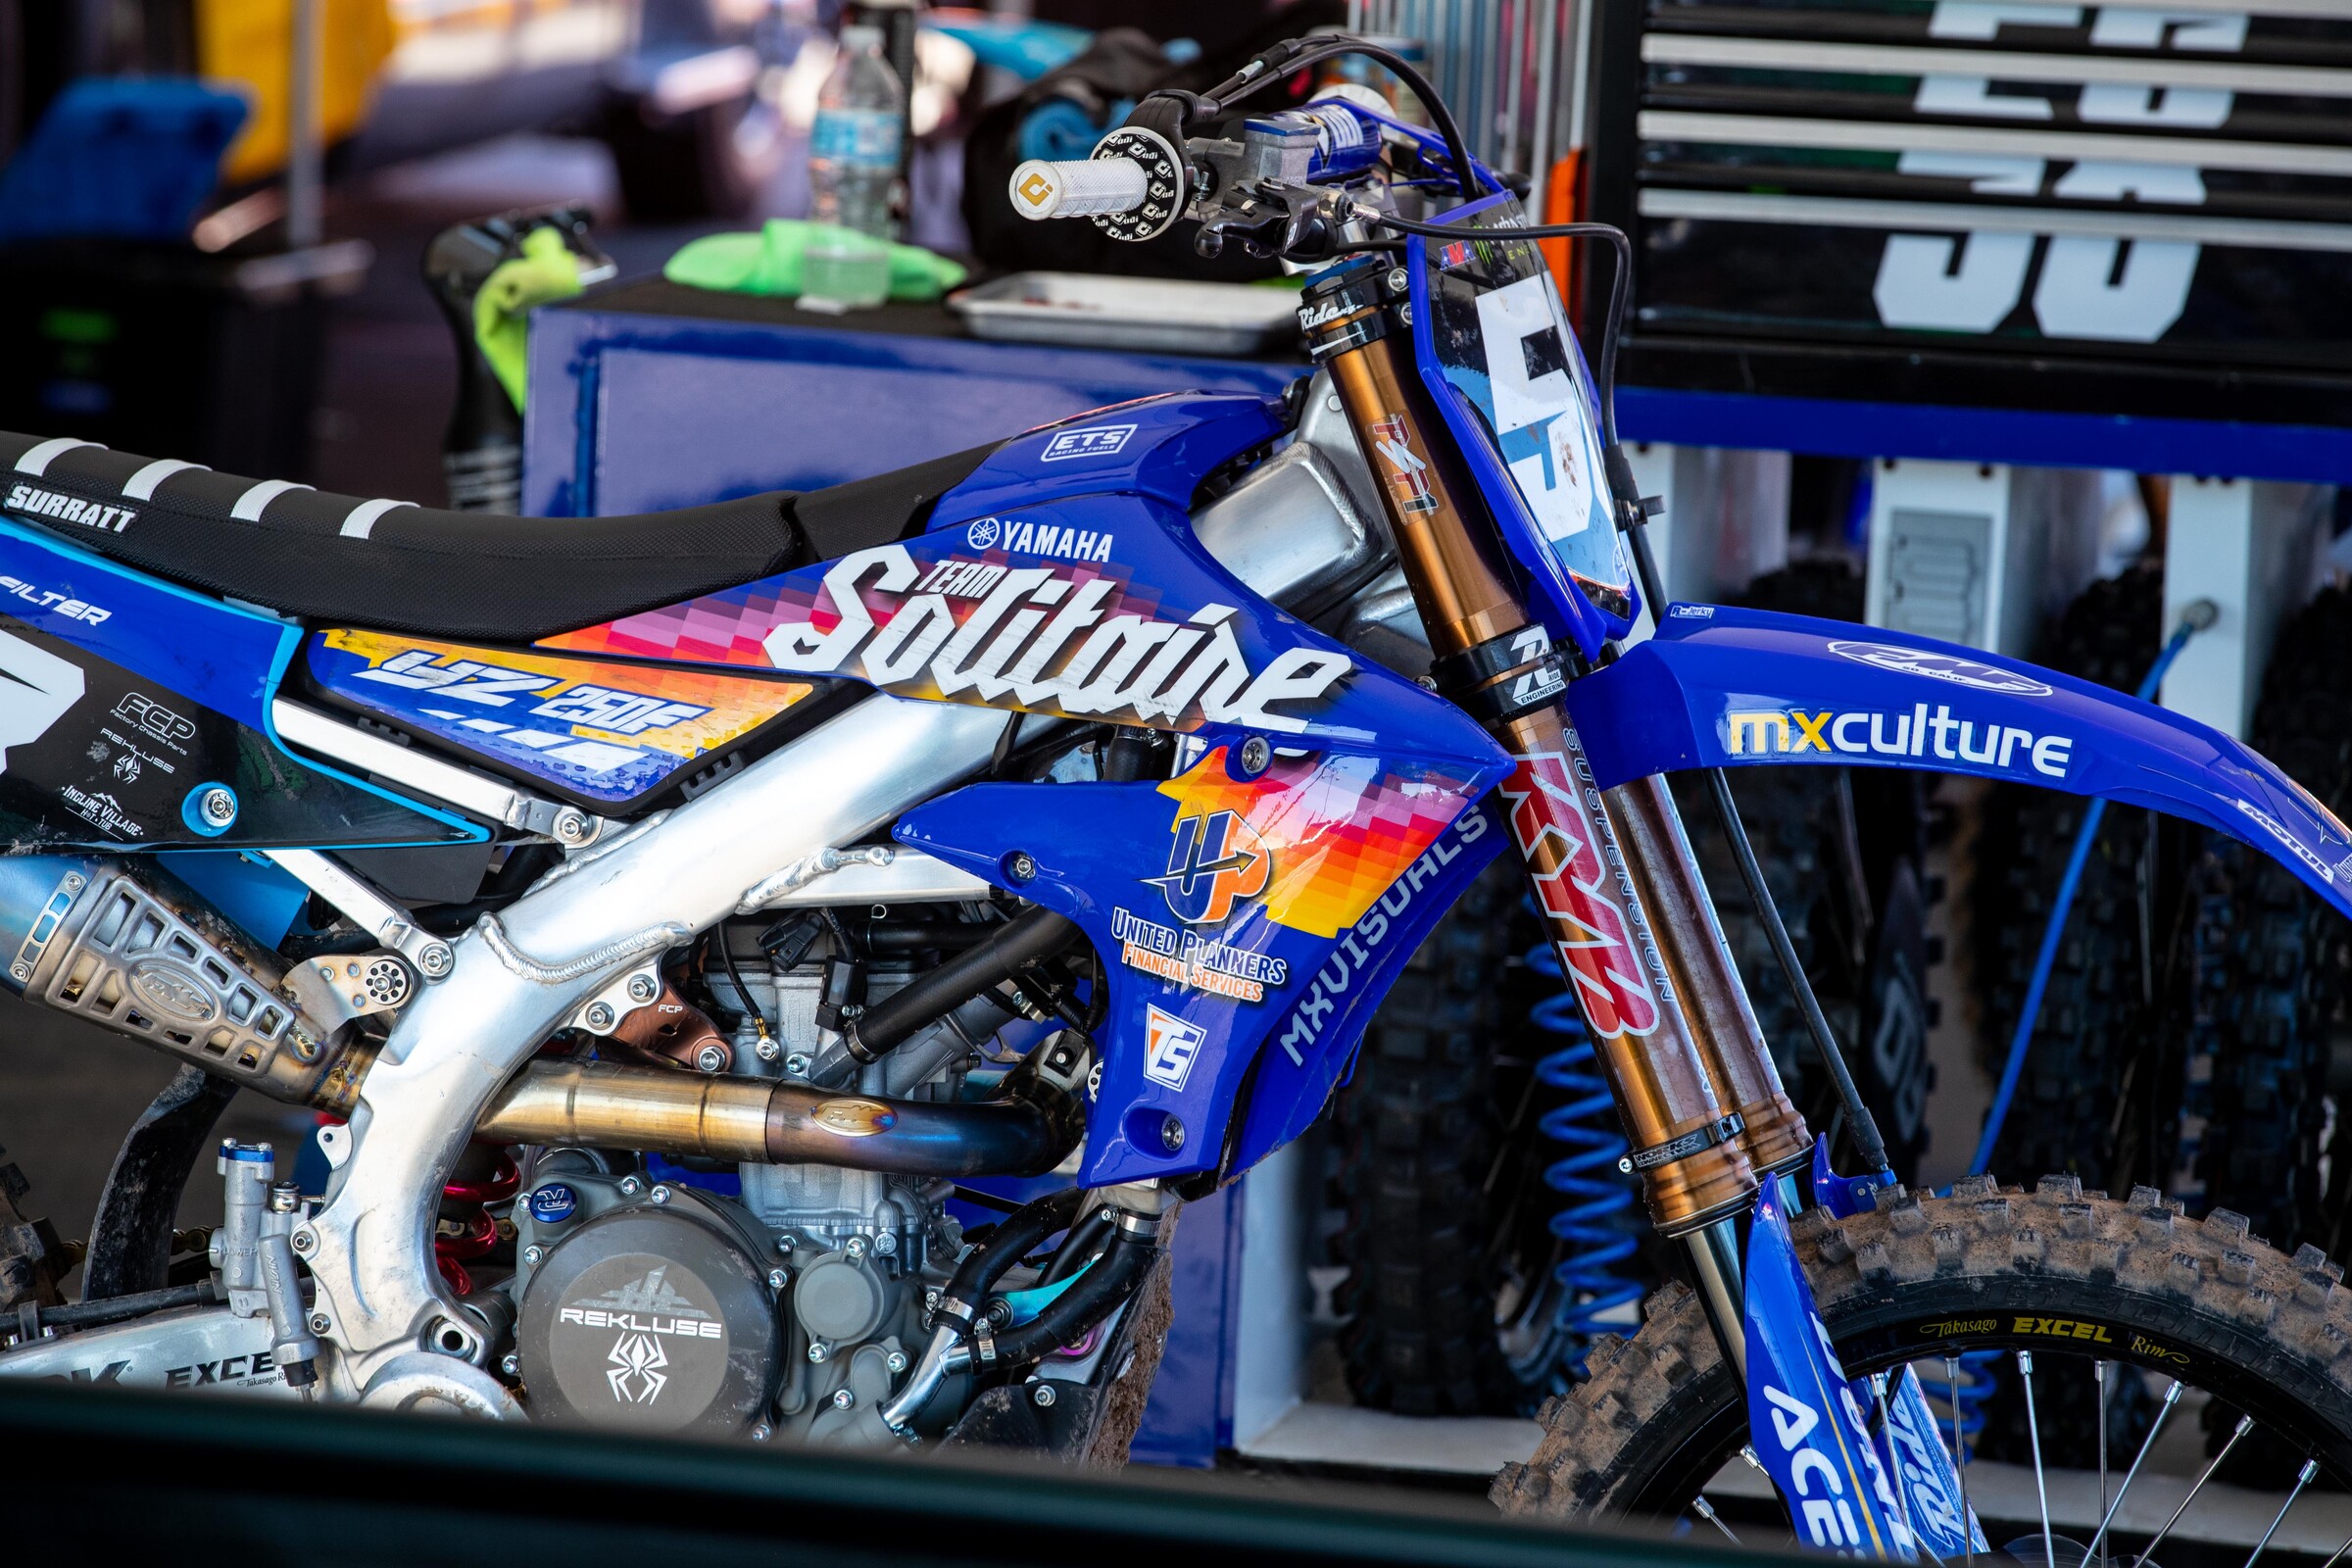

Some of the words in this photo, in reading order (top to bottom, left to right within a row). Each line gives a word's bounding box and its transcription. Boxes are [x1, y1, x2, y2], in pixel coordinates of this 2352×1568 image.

[1440, 240, 1475, 270] AMA
[1475, 271, 1607, 542] 5
[1049, 448, 1085, 457] RACING
[1087, 444, 1115, 453] FUELS
[1054, 430, 1126, 451] ETS
[8, 485, 136, 533] SURRATT
[1002, 520, 1113, 563] YAMAHA
[914, 559, 1000, 599] TEAM
[762, 544, 1352, 733] Solitaire
[117, 692, 196, 740] FCP
[529, 684, 711, 733] 250F
[1520, 681, 1564, 704] ENGINEERING
[100, 727, 175, 774] REKLUSE
[110, 709, 138, 728] Factory
[138, 725, 167, 745] Chassis
[167, 740, 188, 757] Parts
[1729, 703, 2074, 778] mxculture
[63, 785, 103, 813] INCLINE
[100, 805, 142, 837] VILLAGE
[98, 818, 114, 831] TUB
[1562, 727, 1675, 1003] SUSPENSION
[2244, 807, 2329, 878] MOTUL
[1111, 906, 1176, 956] UNITED
[1180, 931, 1287, 985] PLANNERS
[1122, 942, 1190, 983] FINANCIAL
[1191, 966, 1263, 1003] SERVICES
[658, 1004, 683, 1013] FCP
[1635, 1133, 1698, 1160] WORKS
[560, 1307, 722, 1340] REKLUSE
[1919, 1316, 1997, 1339] Takasago
[2012, 1316, 2114, 1344] EXCEL
[2131, 1335, 2191, 1364] Rim
[164, 1350, 286, 1390] EXCE
[236, 1374, 277, 1389] Takasago
